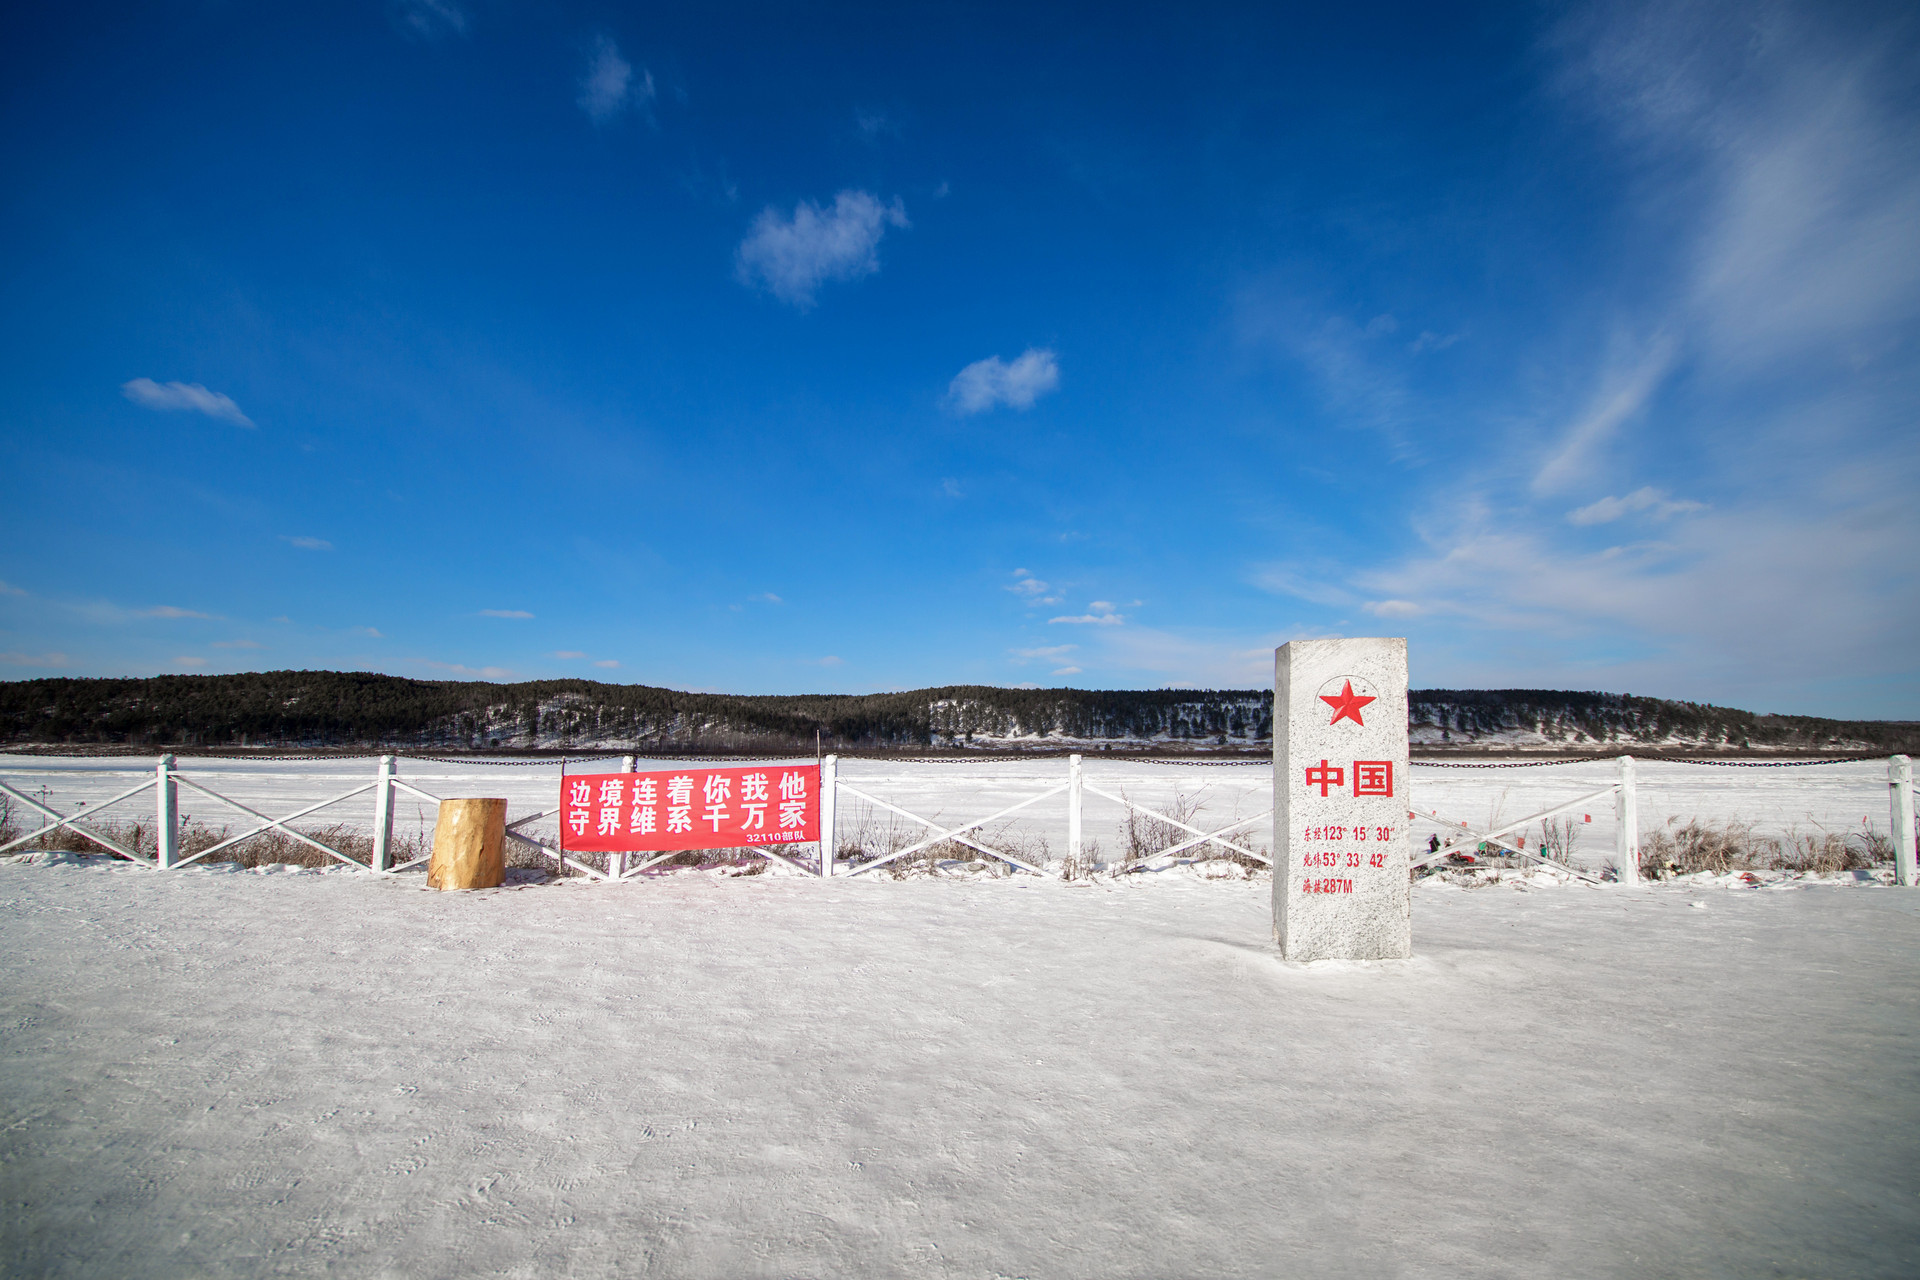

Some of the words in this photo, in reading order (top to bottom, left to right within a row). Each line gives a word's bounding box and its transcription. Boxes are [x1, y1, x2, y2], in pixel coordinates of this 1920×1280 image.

[569, 772, 807, 807] 边境连着你我他
[1305, 759, 1394, 798] 中国
[568, 800, 807, 836] 守界维系千万家
[746, 830, 806, 843] 32110部队
